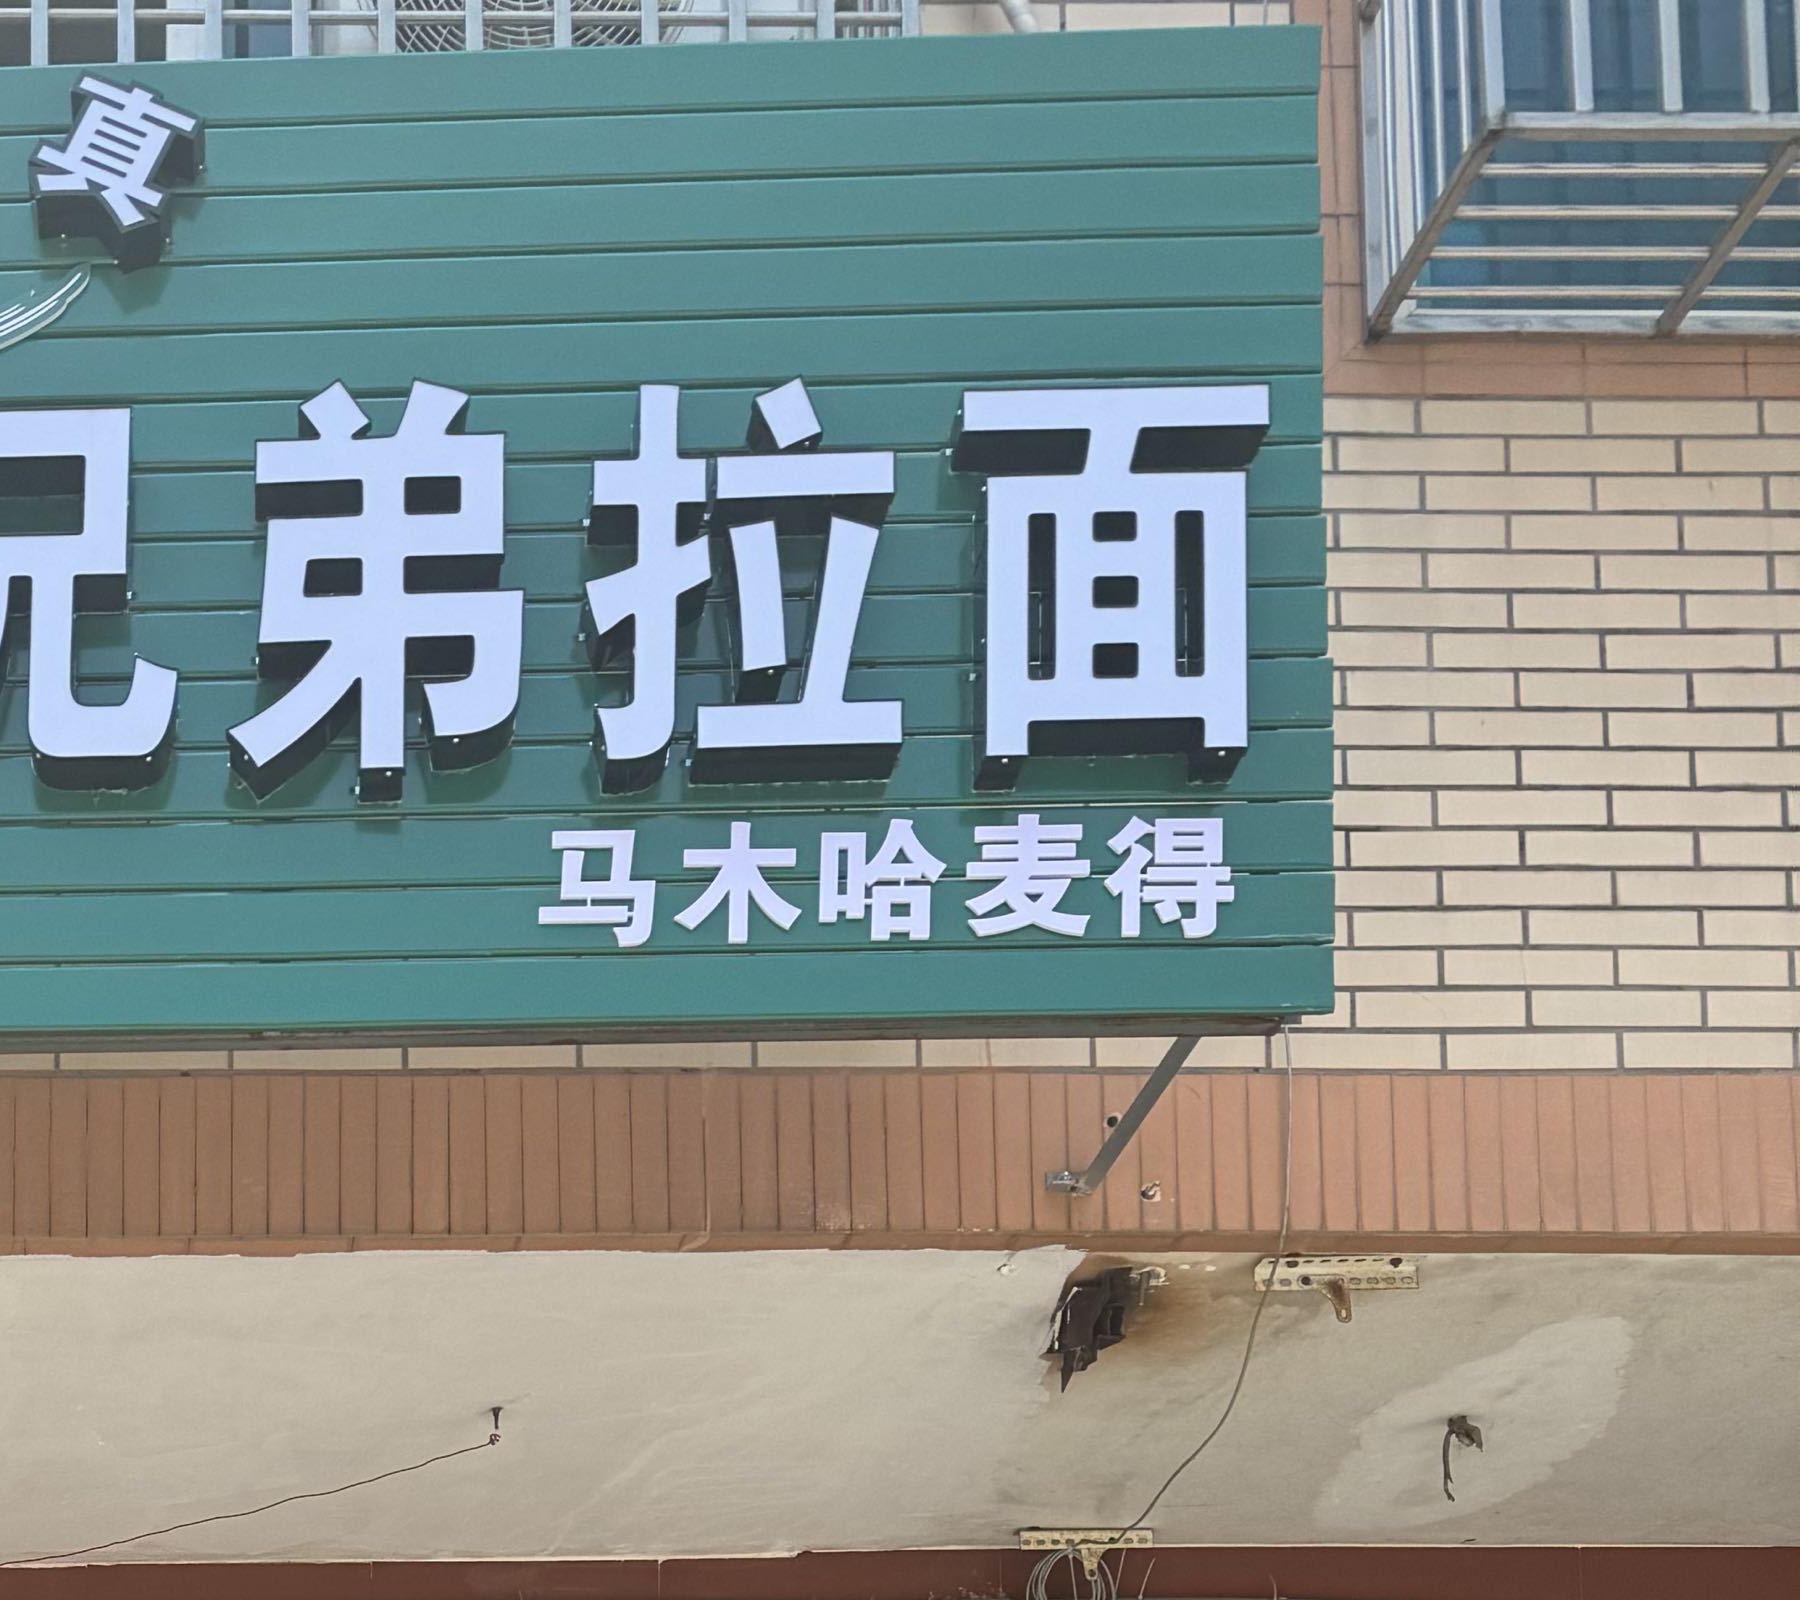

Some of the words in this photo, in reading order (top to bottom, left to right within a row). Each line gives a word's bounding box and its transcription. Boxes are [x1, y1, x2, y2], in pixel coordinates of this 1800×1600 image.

[538, 815, 1235, 947] 马木哈麦得
